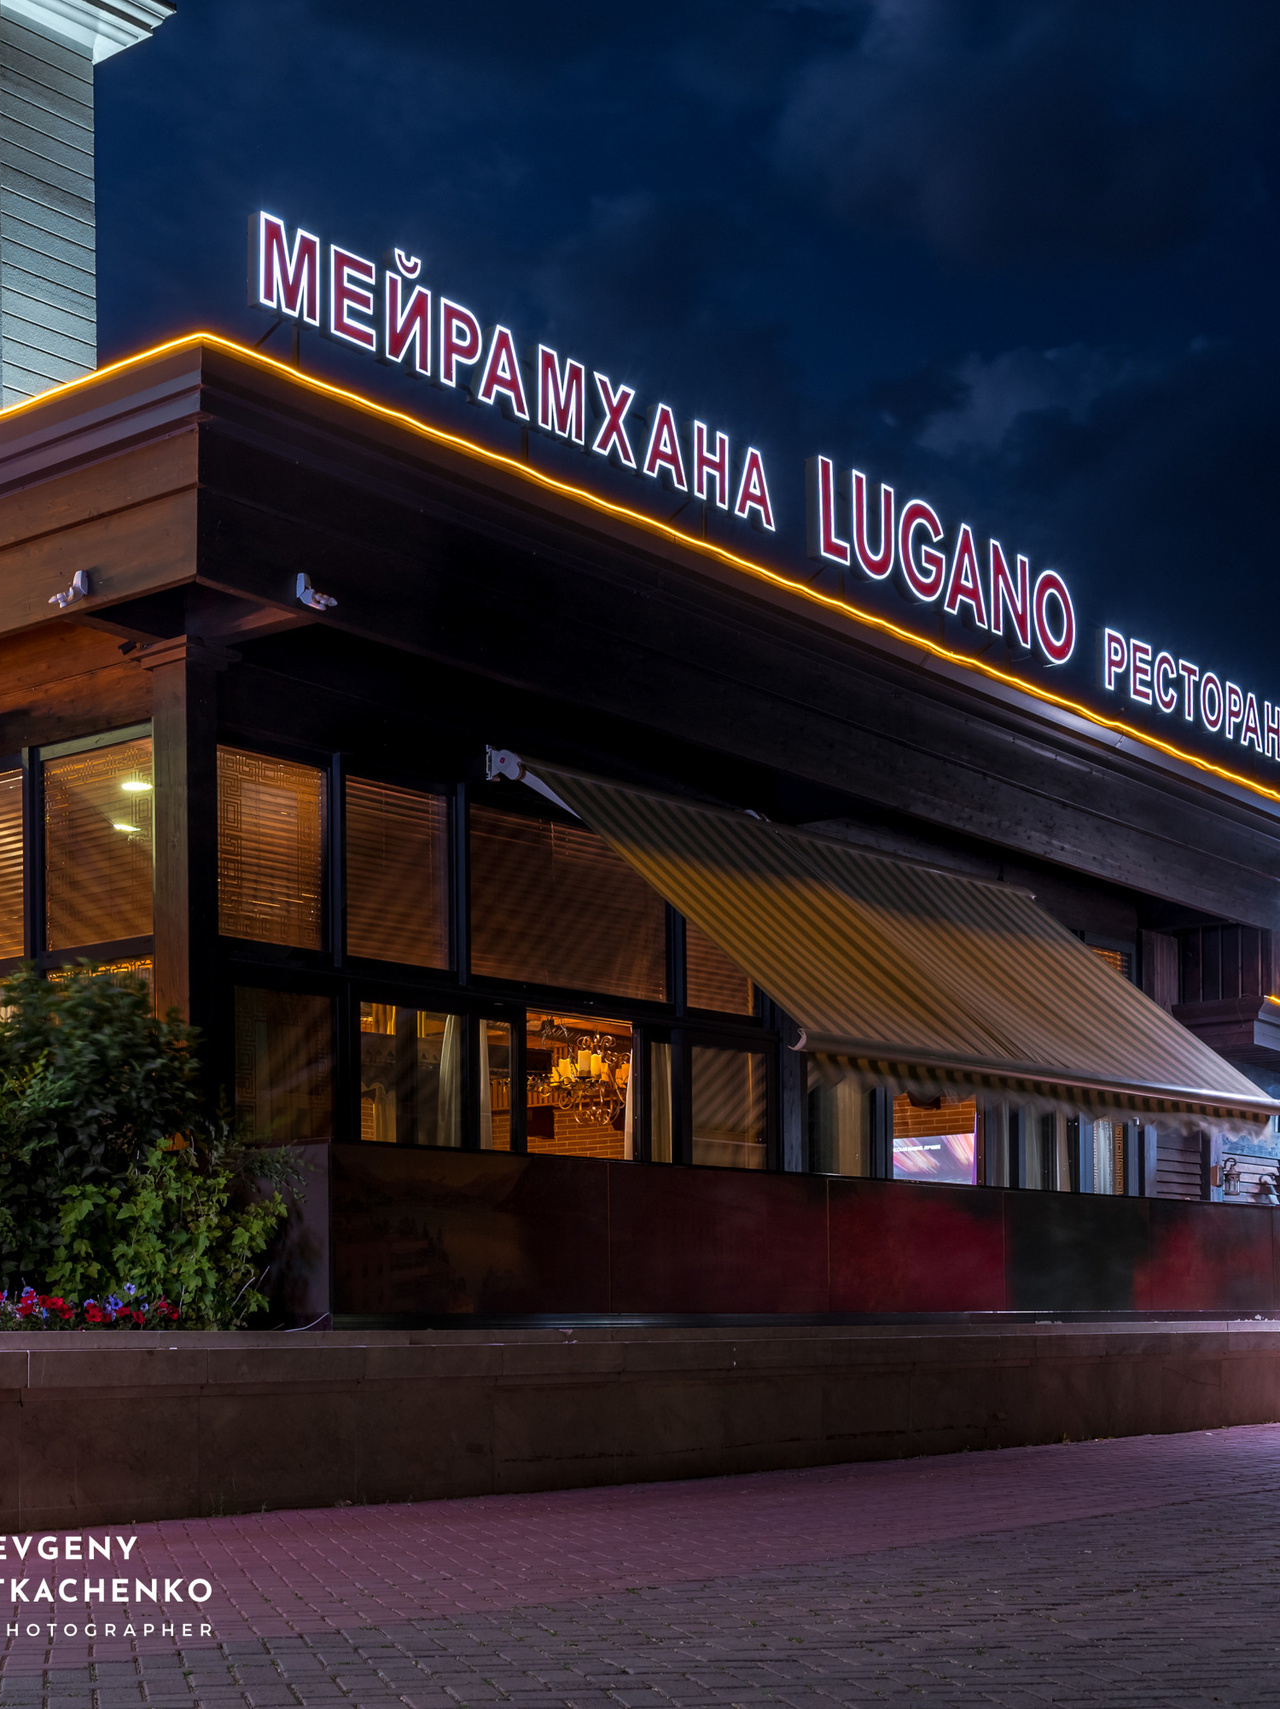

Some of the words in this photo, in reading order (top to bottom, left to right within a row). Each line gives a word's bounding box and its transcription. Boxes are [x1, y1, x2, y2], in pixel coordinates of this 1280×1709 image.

[258, 209, 775, 532] МЕЙРАМХАНА
[816, 455, 1076, 665] LUGANO
[1104, 627, 1280, 763] РЕСТОРАН
